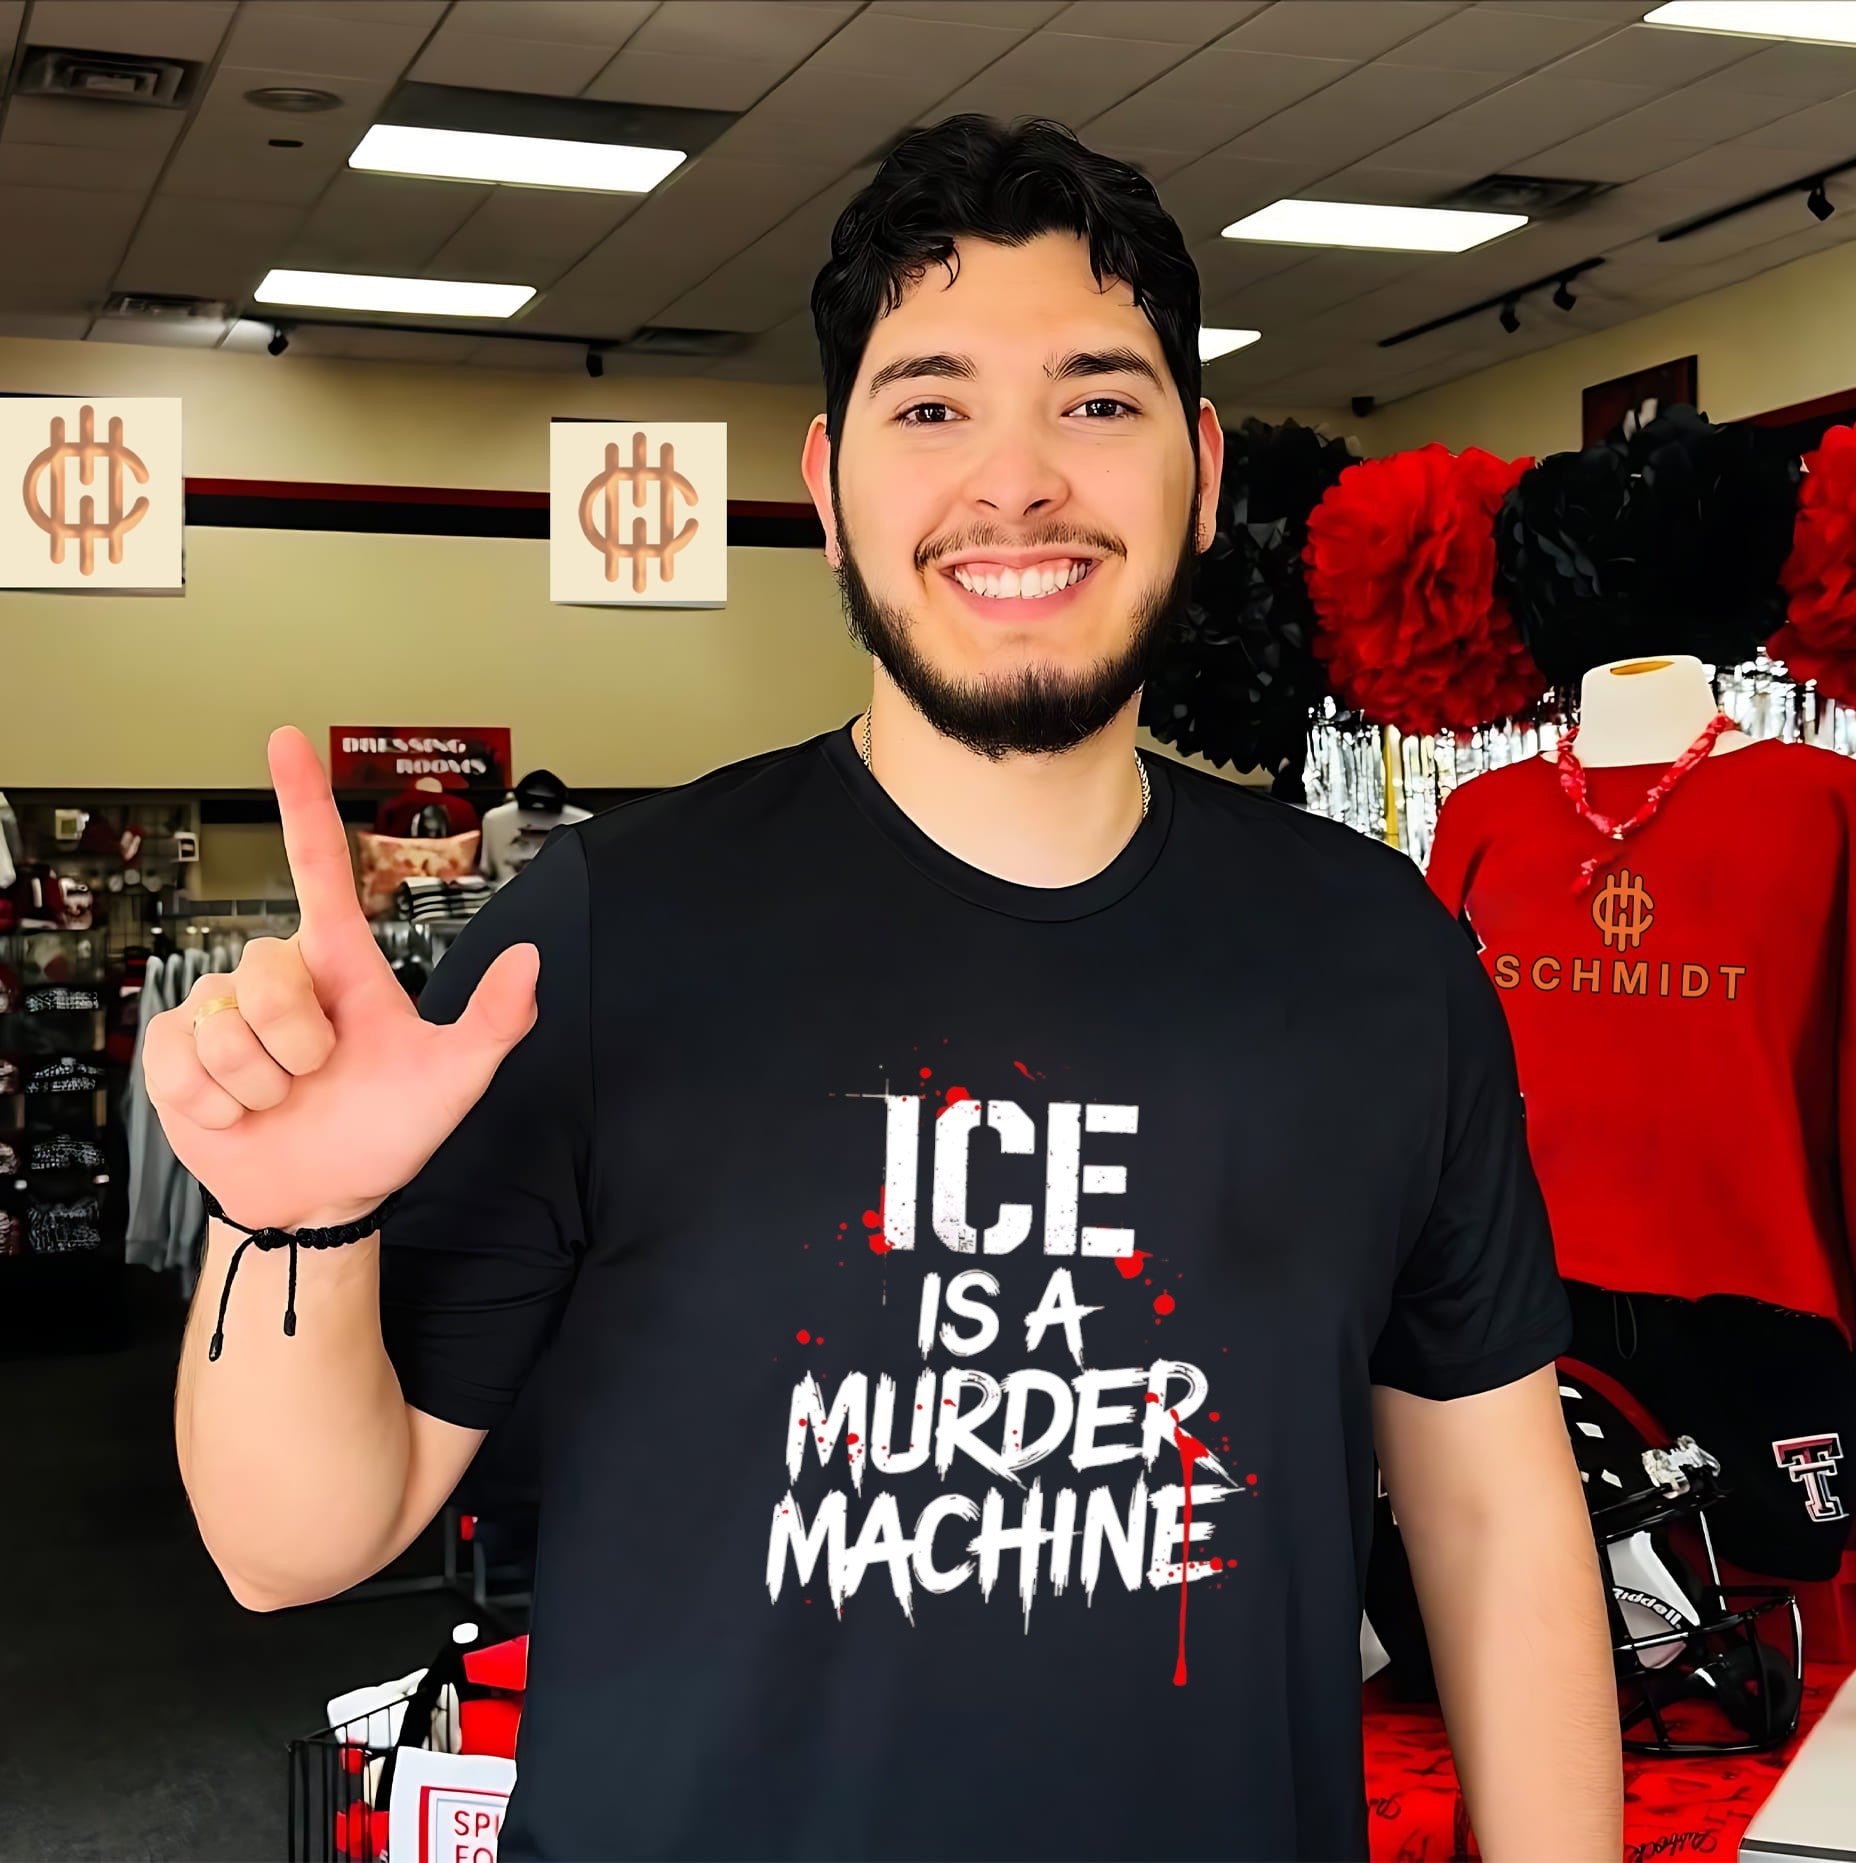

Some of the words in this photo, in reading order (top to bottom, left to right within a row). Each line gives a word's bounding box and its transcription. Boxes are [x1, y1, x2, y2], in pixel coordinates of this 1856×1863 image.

[342, 737, 466, 753] DRESSING
[396, 758, 487, 775] ROOMS
[1494, 953, 1747, 1001] SCHMIDT
[884, 1095, 1139, 1257] ICE
[918, 1269, 1000, 1360] IS
[1024, 1267, 1104, 1374] A
[786, 1358, 1240, 1497] MURDER
[766, 1469, 1246, 1635] MACHINE
